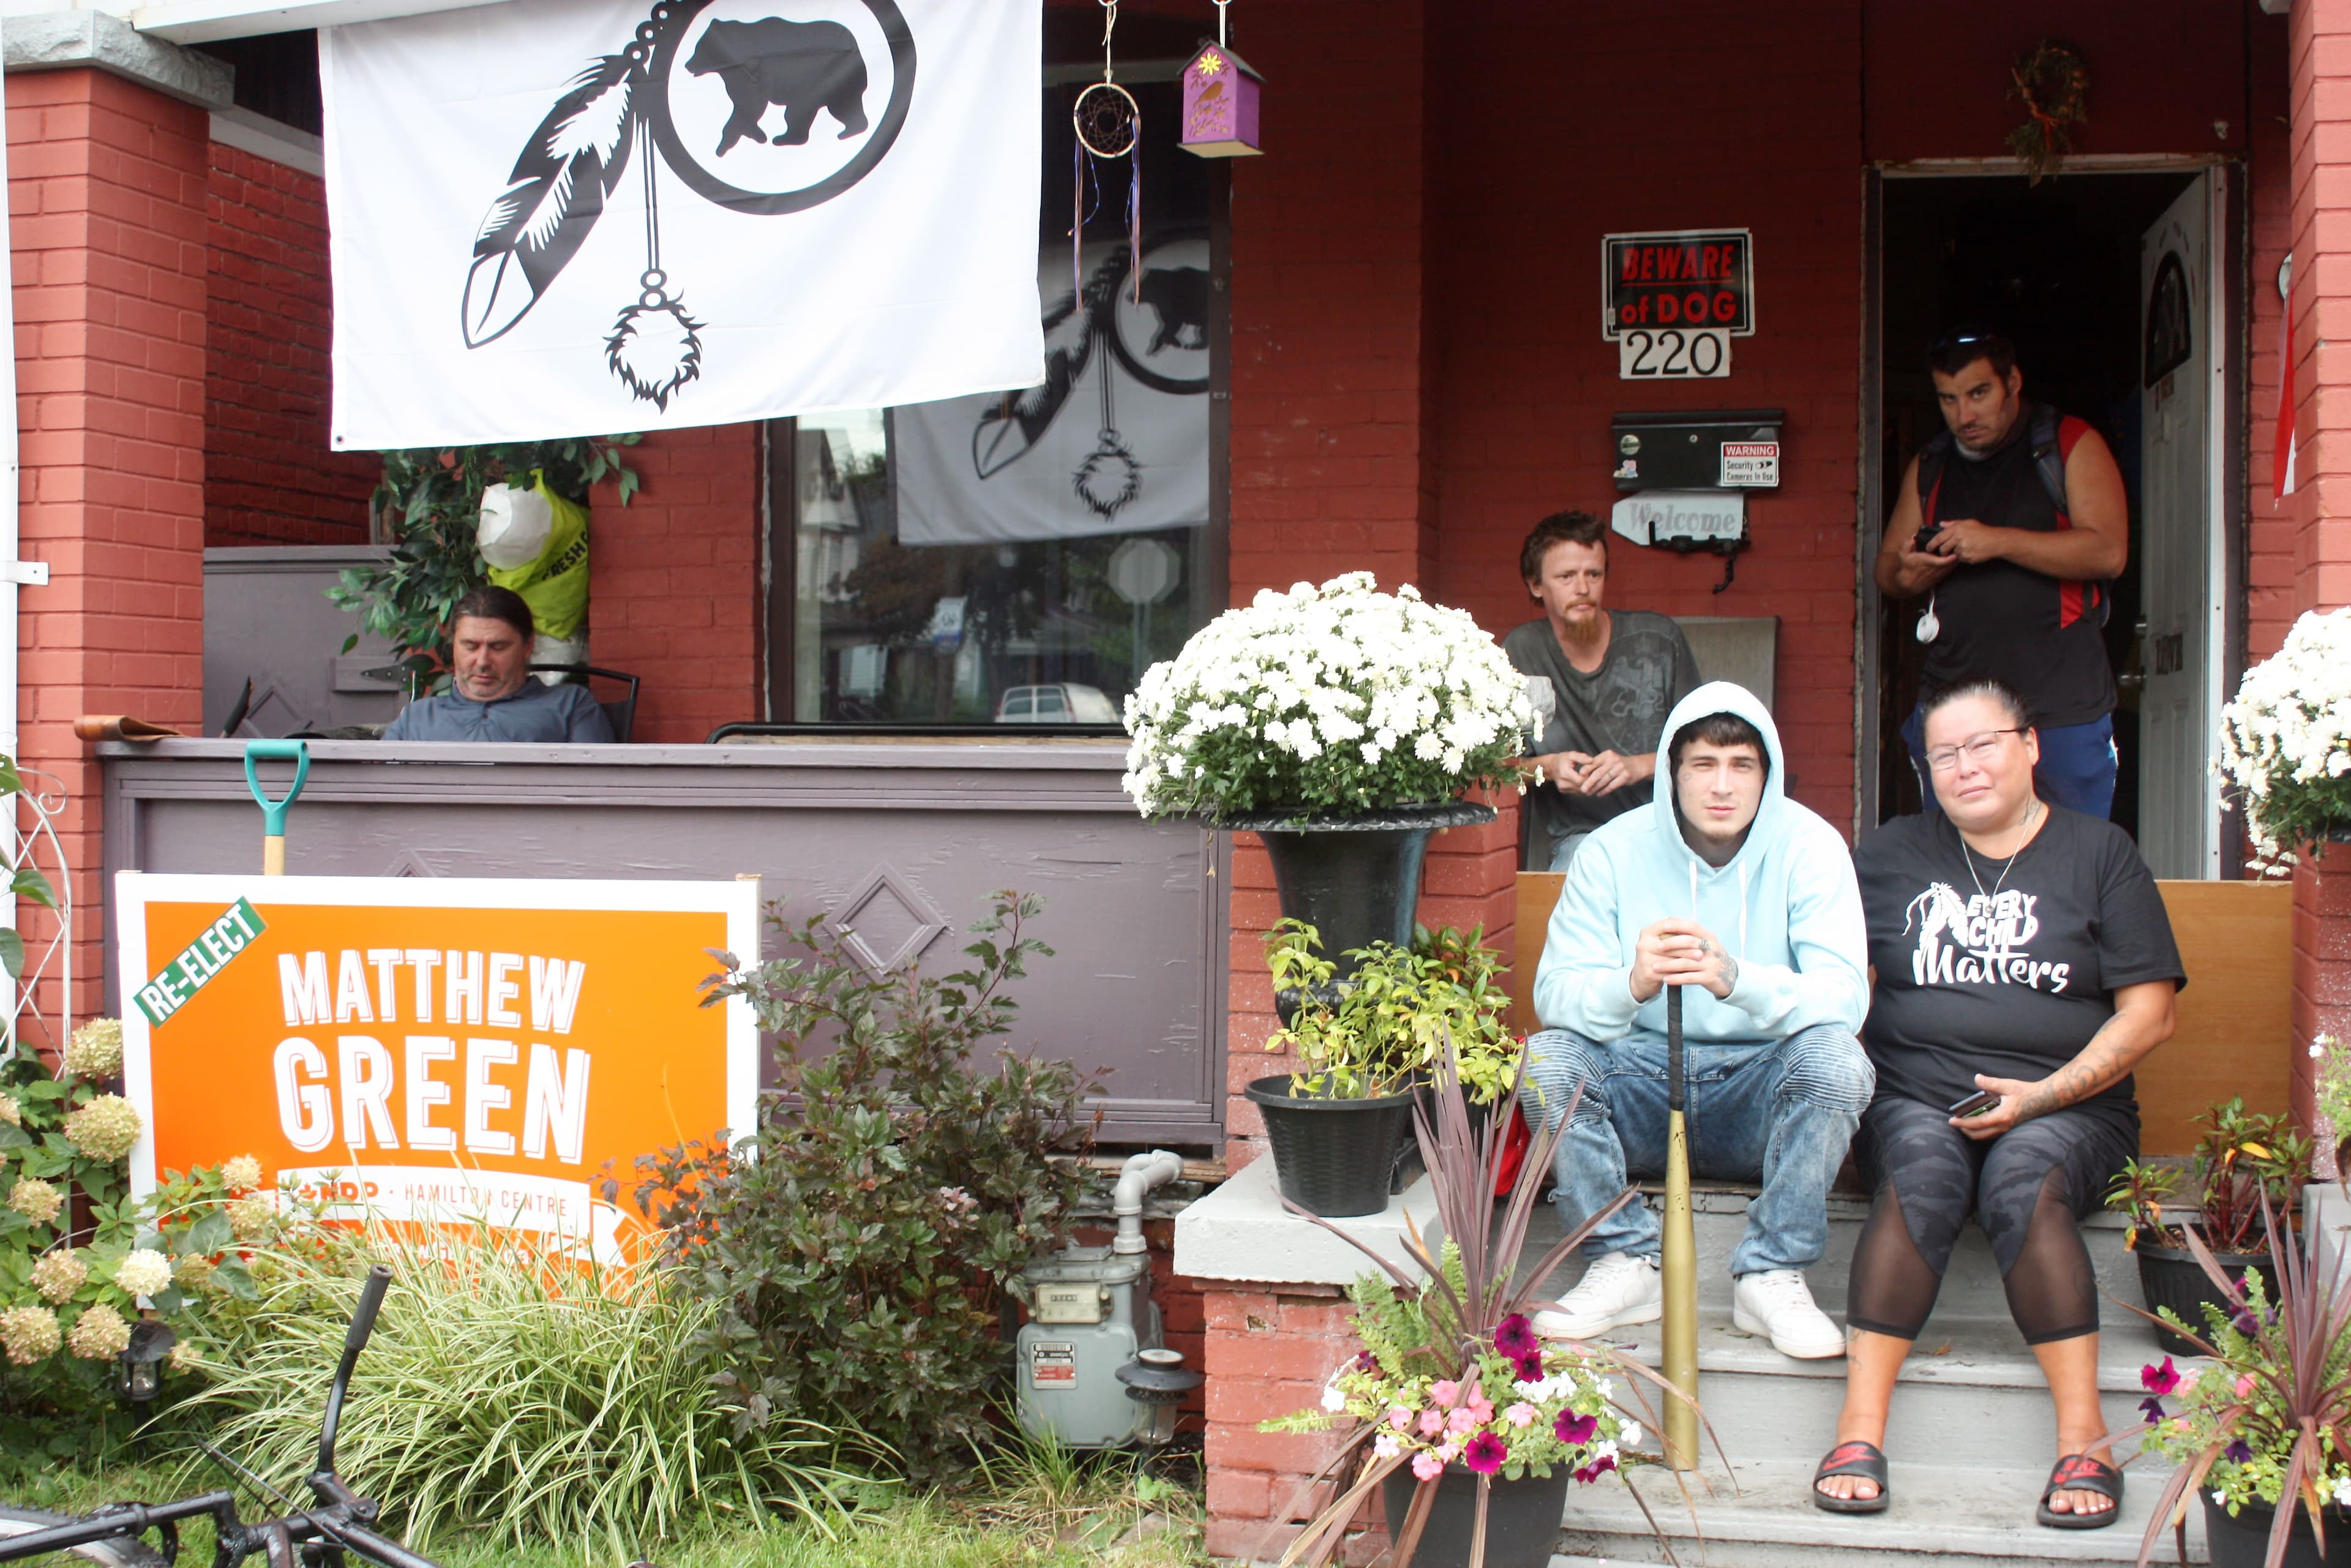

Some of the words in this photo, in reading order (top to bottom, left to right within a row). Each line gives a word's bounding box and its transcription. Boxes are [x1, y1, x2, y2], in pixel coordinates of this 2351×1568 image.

[1621, 244, 1734, 280] BEWARE
[1620, 295, 1649, 324] of
[1657, 291, 1737, 324] DOG
[1626, 329, 1723, 376] 220
[1727, 446, 1774, 456] WARNING
[1727, 460, 1753, 471] Security
[1727, 472, 1752, 481] Cameras
[1763, 472, 1774, 481] Use
[1629, 502, 1736, 533] Welcome
[1967, 890, 2038, 919] EVERY
[1968, 915, 2039, 946] CHILD
[140, 903, 256, 1022] RE-ELECT
[1913, 937, 2071, 993] Matters
[278, 948, 586, 1035] MATTHEW
[273, 1035, 591, 1165] GREEN
[501, 1190, 567, 1216] CENTRE
